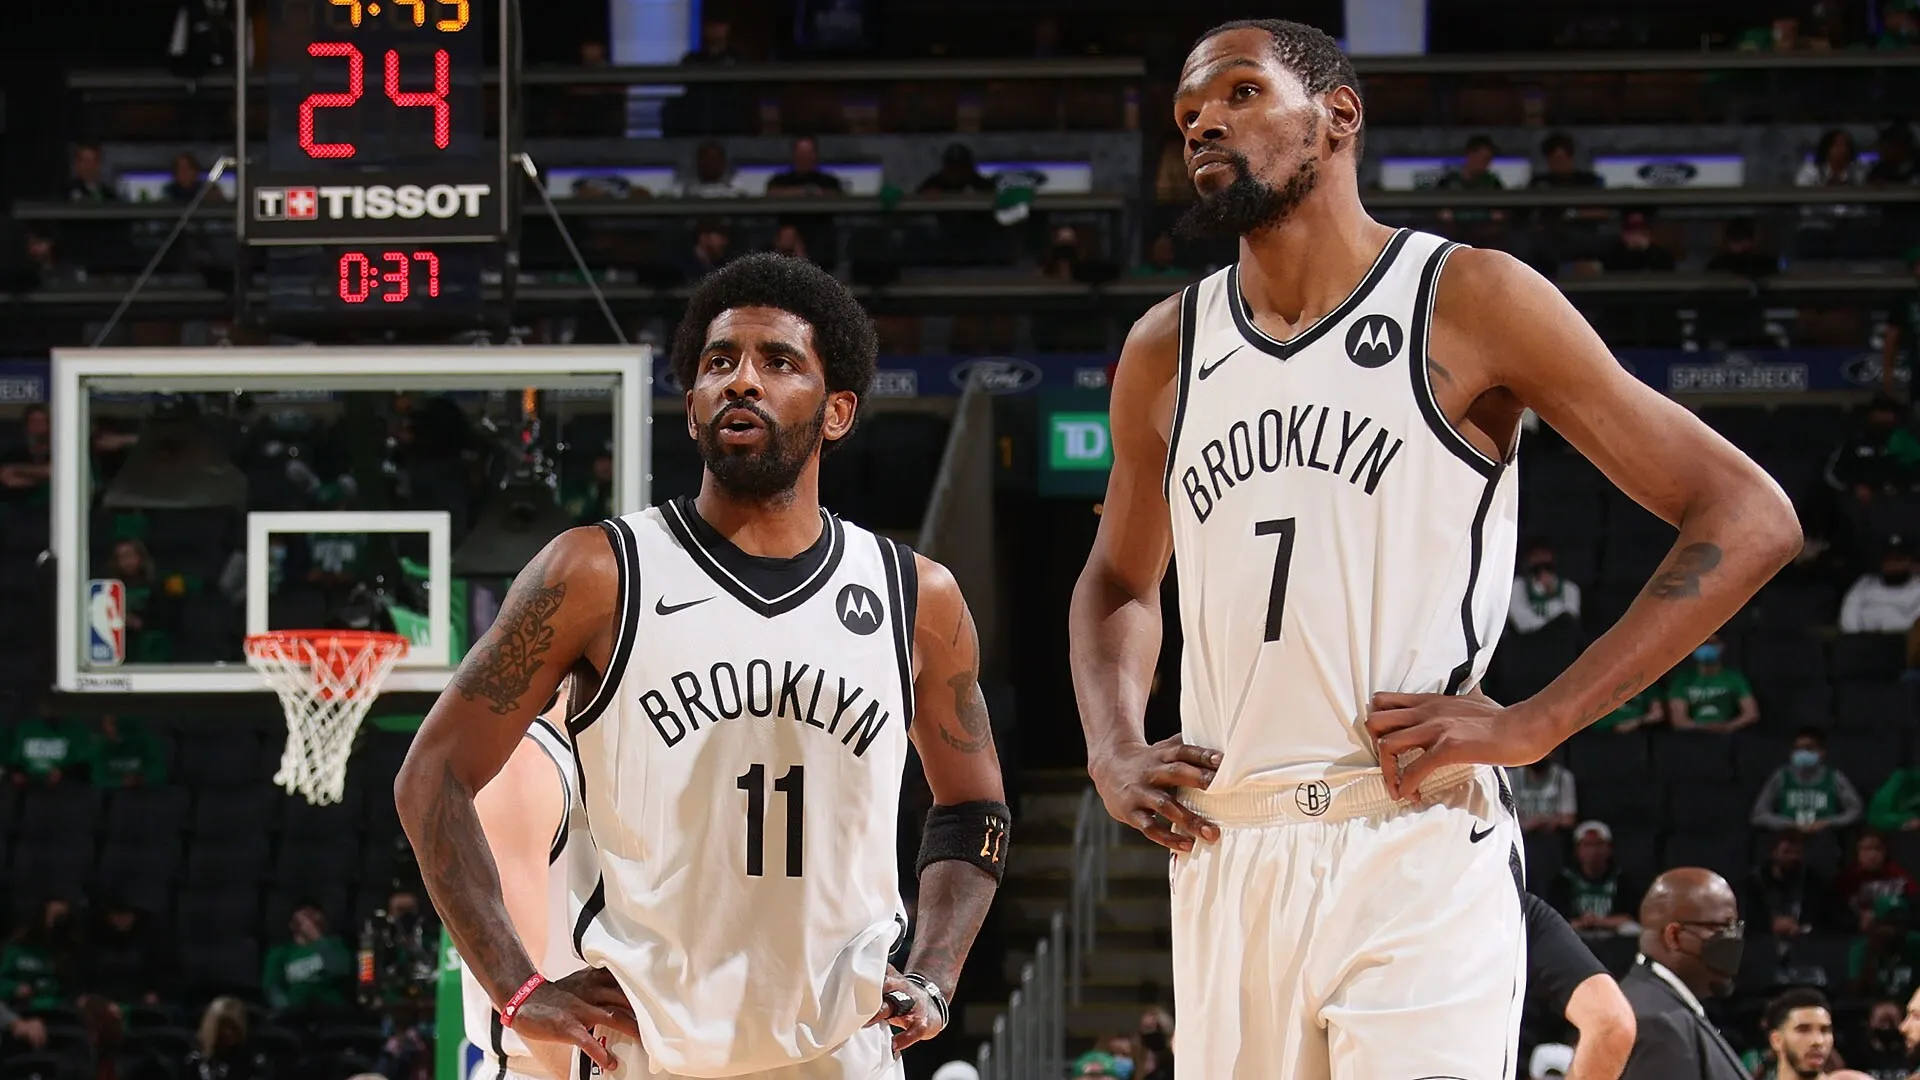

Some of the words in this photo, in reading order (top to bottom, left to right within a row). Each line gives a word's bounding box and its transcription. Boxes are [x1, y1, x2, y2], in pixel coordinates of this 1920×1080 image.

[298, 42, 450, 158] 24
[319, 184, 490, 219] TISSOT
[339, 251, 439, 302] 0:37
[1054, 421, 1108, 460] TD
[1182, 404, 1403, 524] BROOKLYN
[1255, 517, 1296, 643] 7
[639, 659, 890, 758] BROOKLYN
[736, 763, 804, 877] 11
